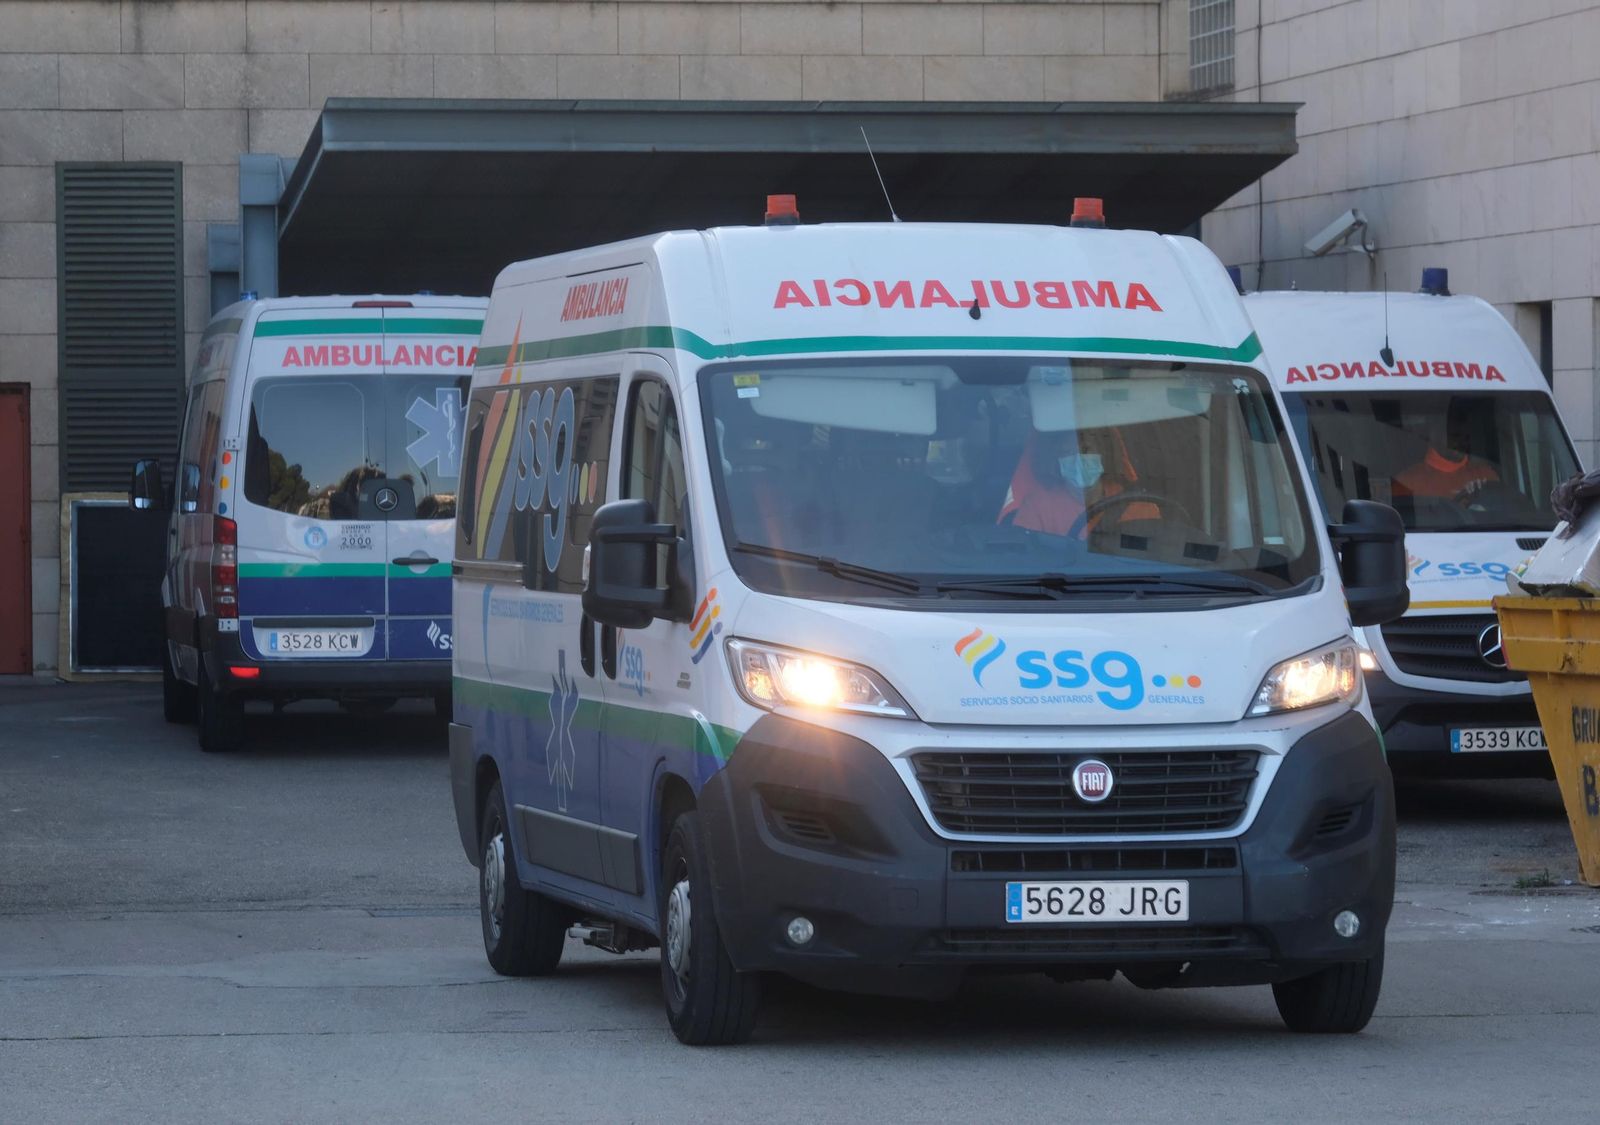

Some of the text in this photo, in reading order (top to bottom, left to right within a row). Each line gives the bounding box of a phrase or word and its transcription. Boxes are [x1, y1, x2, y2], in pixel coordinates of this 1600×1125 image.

[560, 277, 629, 322] AMBULANCIA
[515, 387, 575, 573] ssg
[341, 537, 371, 546] 2000
[1438, 561, 1511, 582] ssg
[282, 634, 359, 649] 3528 KCW
[1015, 650, 1145, 711] ssg
[960, 694, 1205, 707] SERVICIOS SOCIO SANITARIOS GENERALES
[1572, 705, 1600, 744] GRU
[1463, 731, 1510, 749] 3539
[1082, 772, 1105, 791] FIAT
[1026, 887, 1105, 916] 5628
[1119, 887, 1182, 916] JRG
